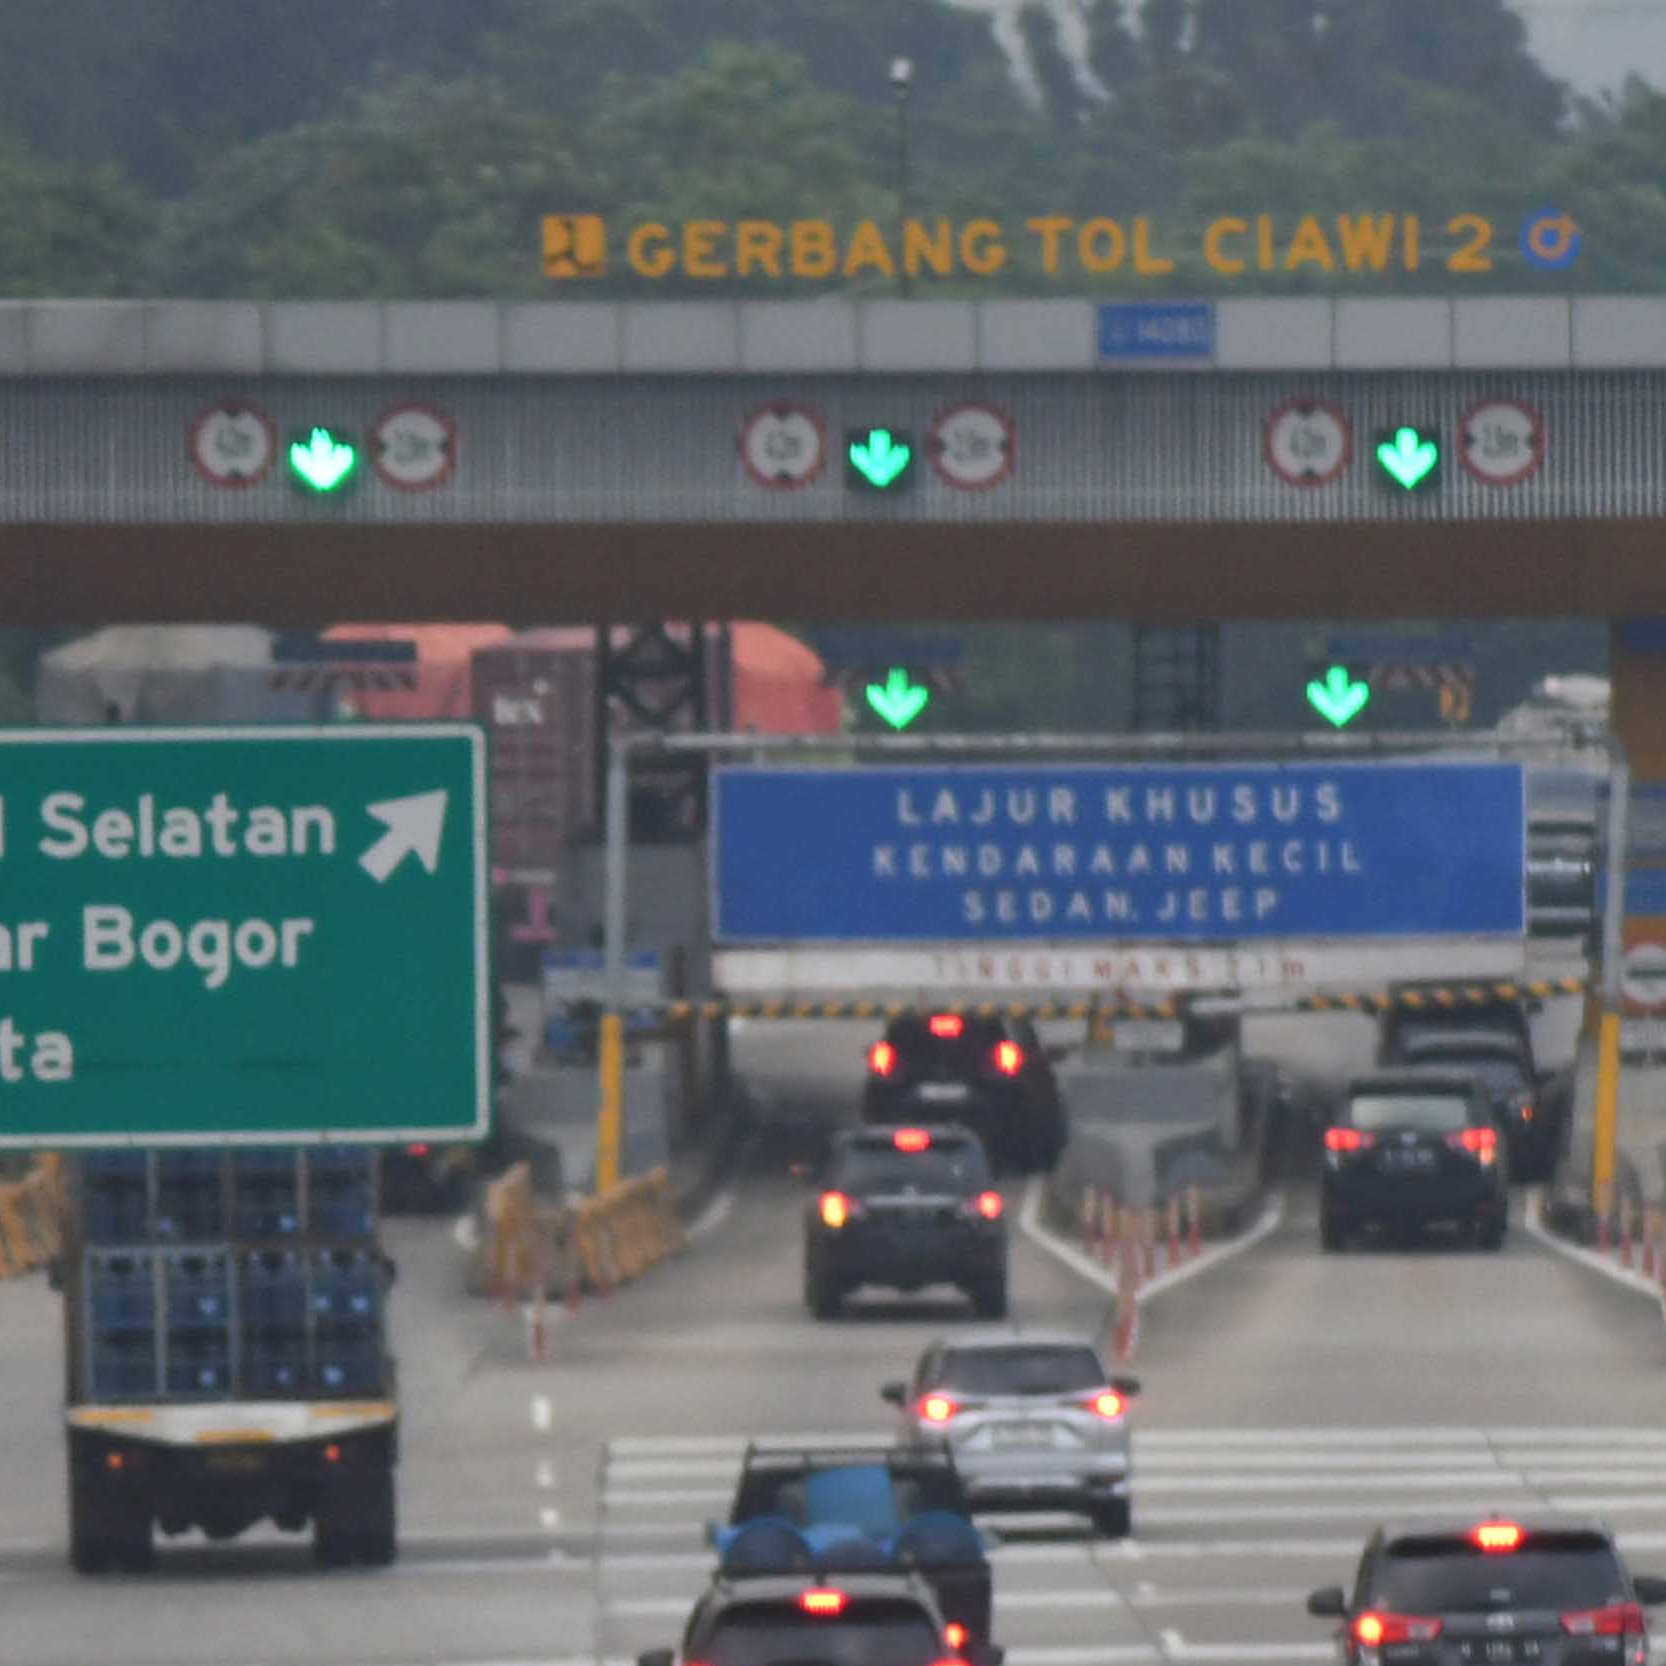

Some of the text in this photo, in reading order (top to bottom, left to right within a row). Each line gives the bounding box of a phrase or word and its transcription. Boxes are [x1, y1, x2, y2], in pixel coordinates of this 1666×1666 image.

[629, 213, 1494, 279] GERBANG TOL CIAWI 2
[38, 792, 336, 859] Selatan
[897, 783, 1344, 826] LAJUR KHUSUS
[874, 840, 1363, 877] KENDARAAN KECIL
[1157, 890, 1280, 922] JEEP
[82, 904, 315, 989] Bogor
